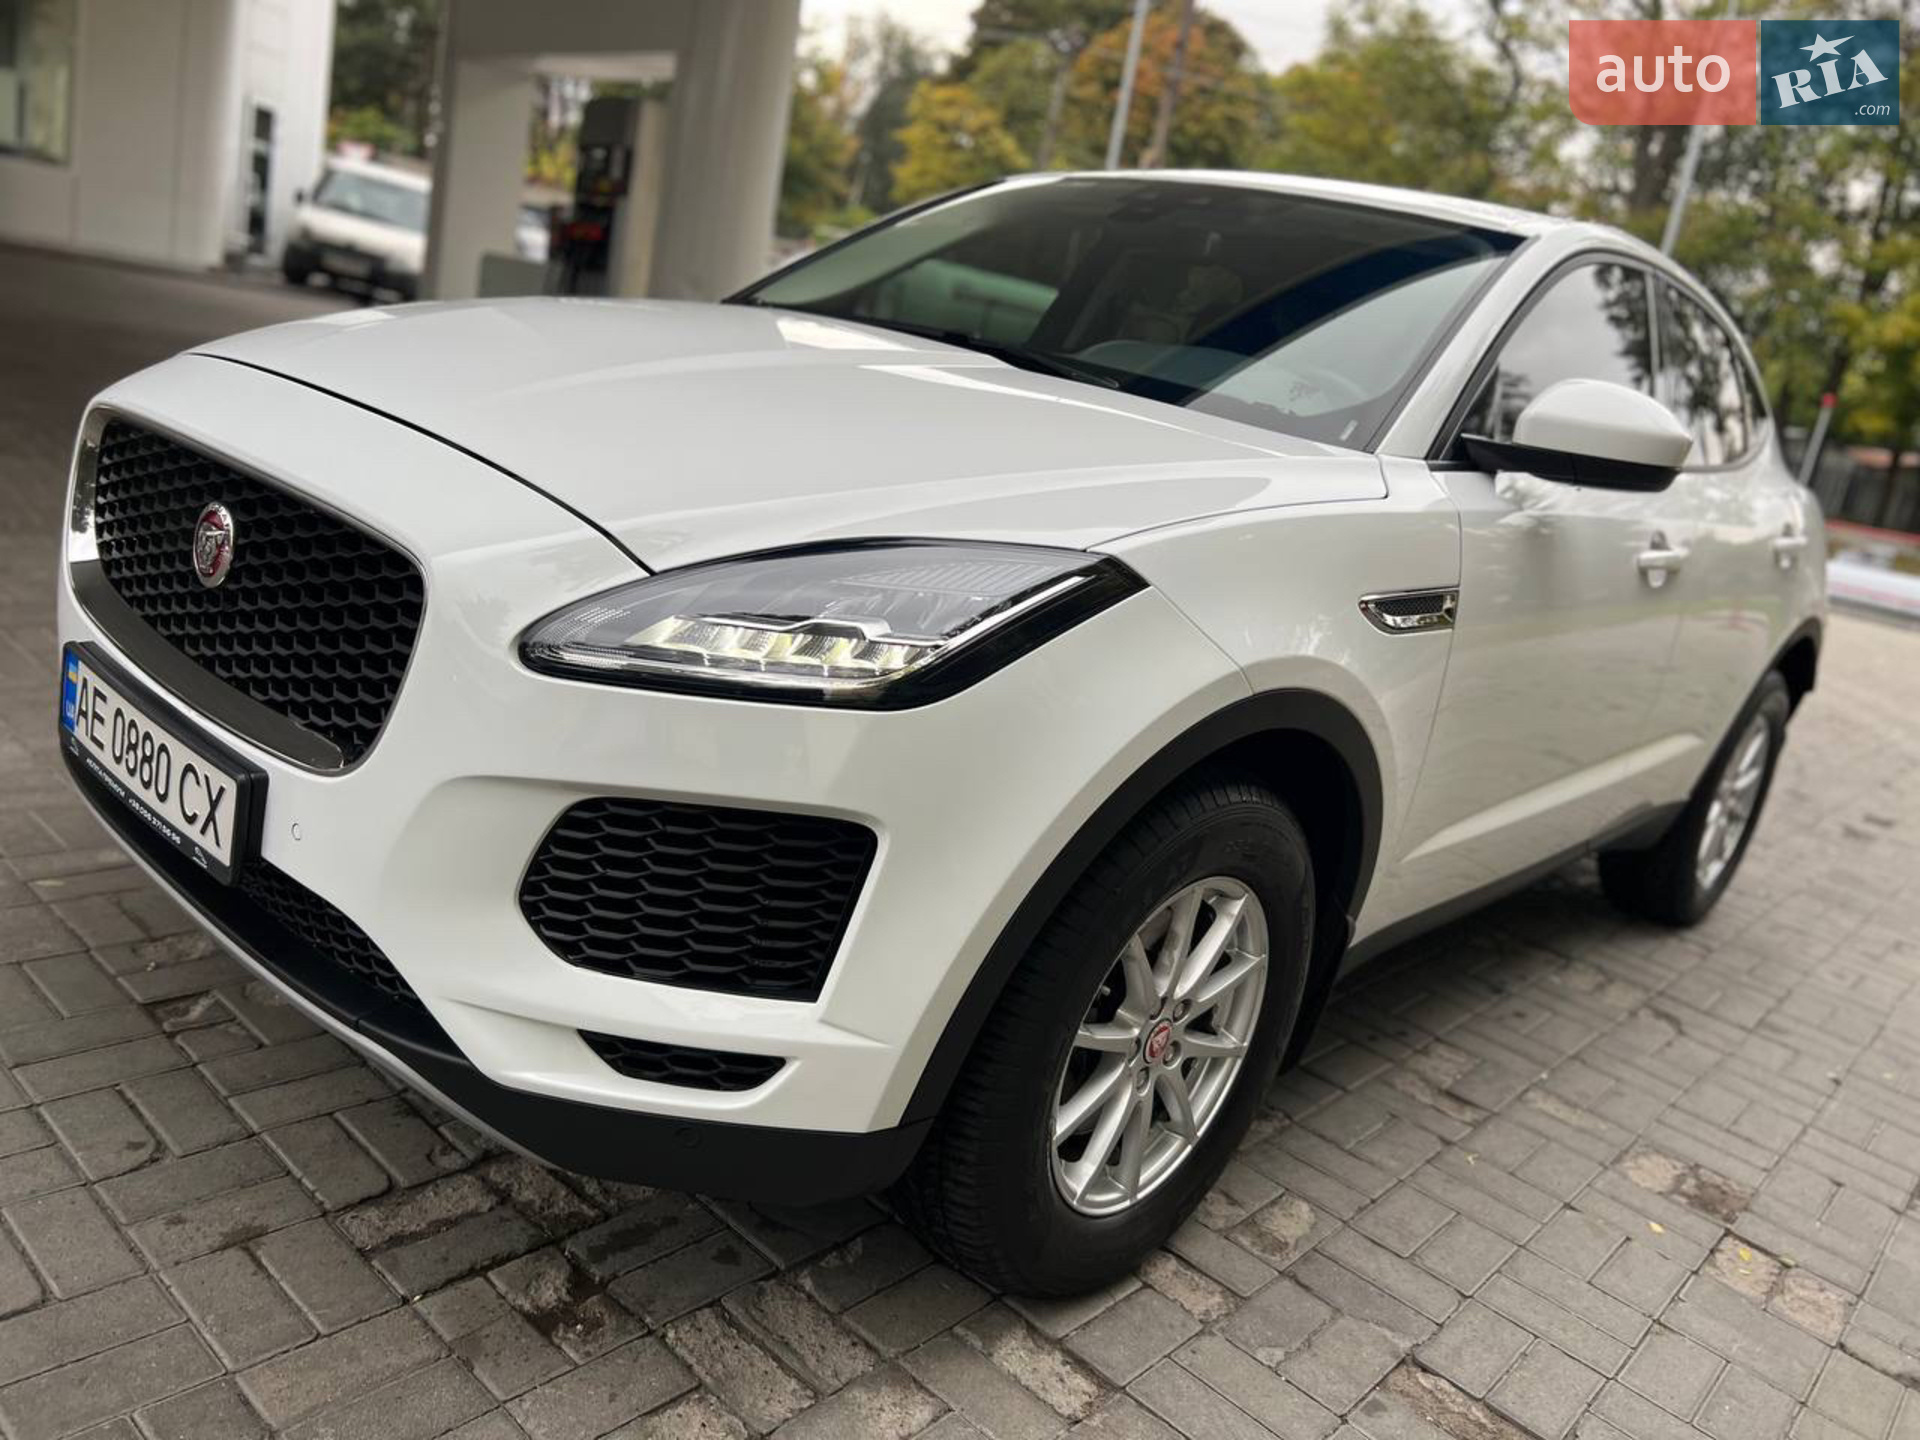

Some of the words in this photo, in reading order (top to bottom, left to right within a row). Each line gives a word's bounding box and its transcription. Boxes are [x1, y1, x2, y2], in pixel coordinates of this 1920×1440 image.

[76, 677, 107, 751] AE
[112, 707, 171, 802] 0880
[179, 762, 226, 848] CX
